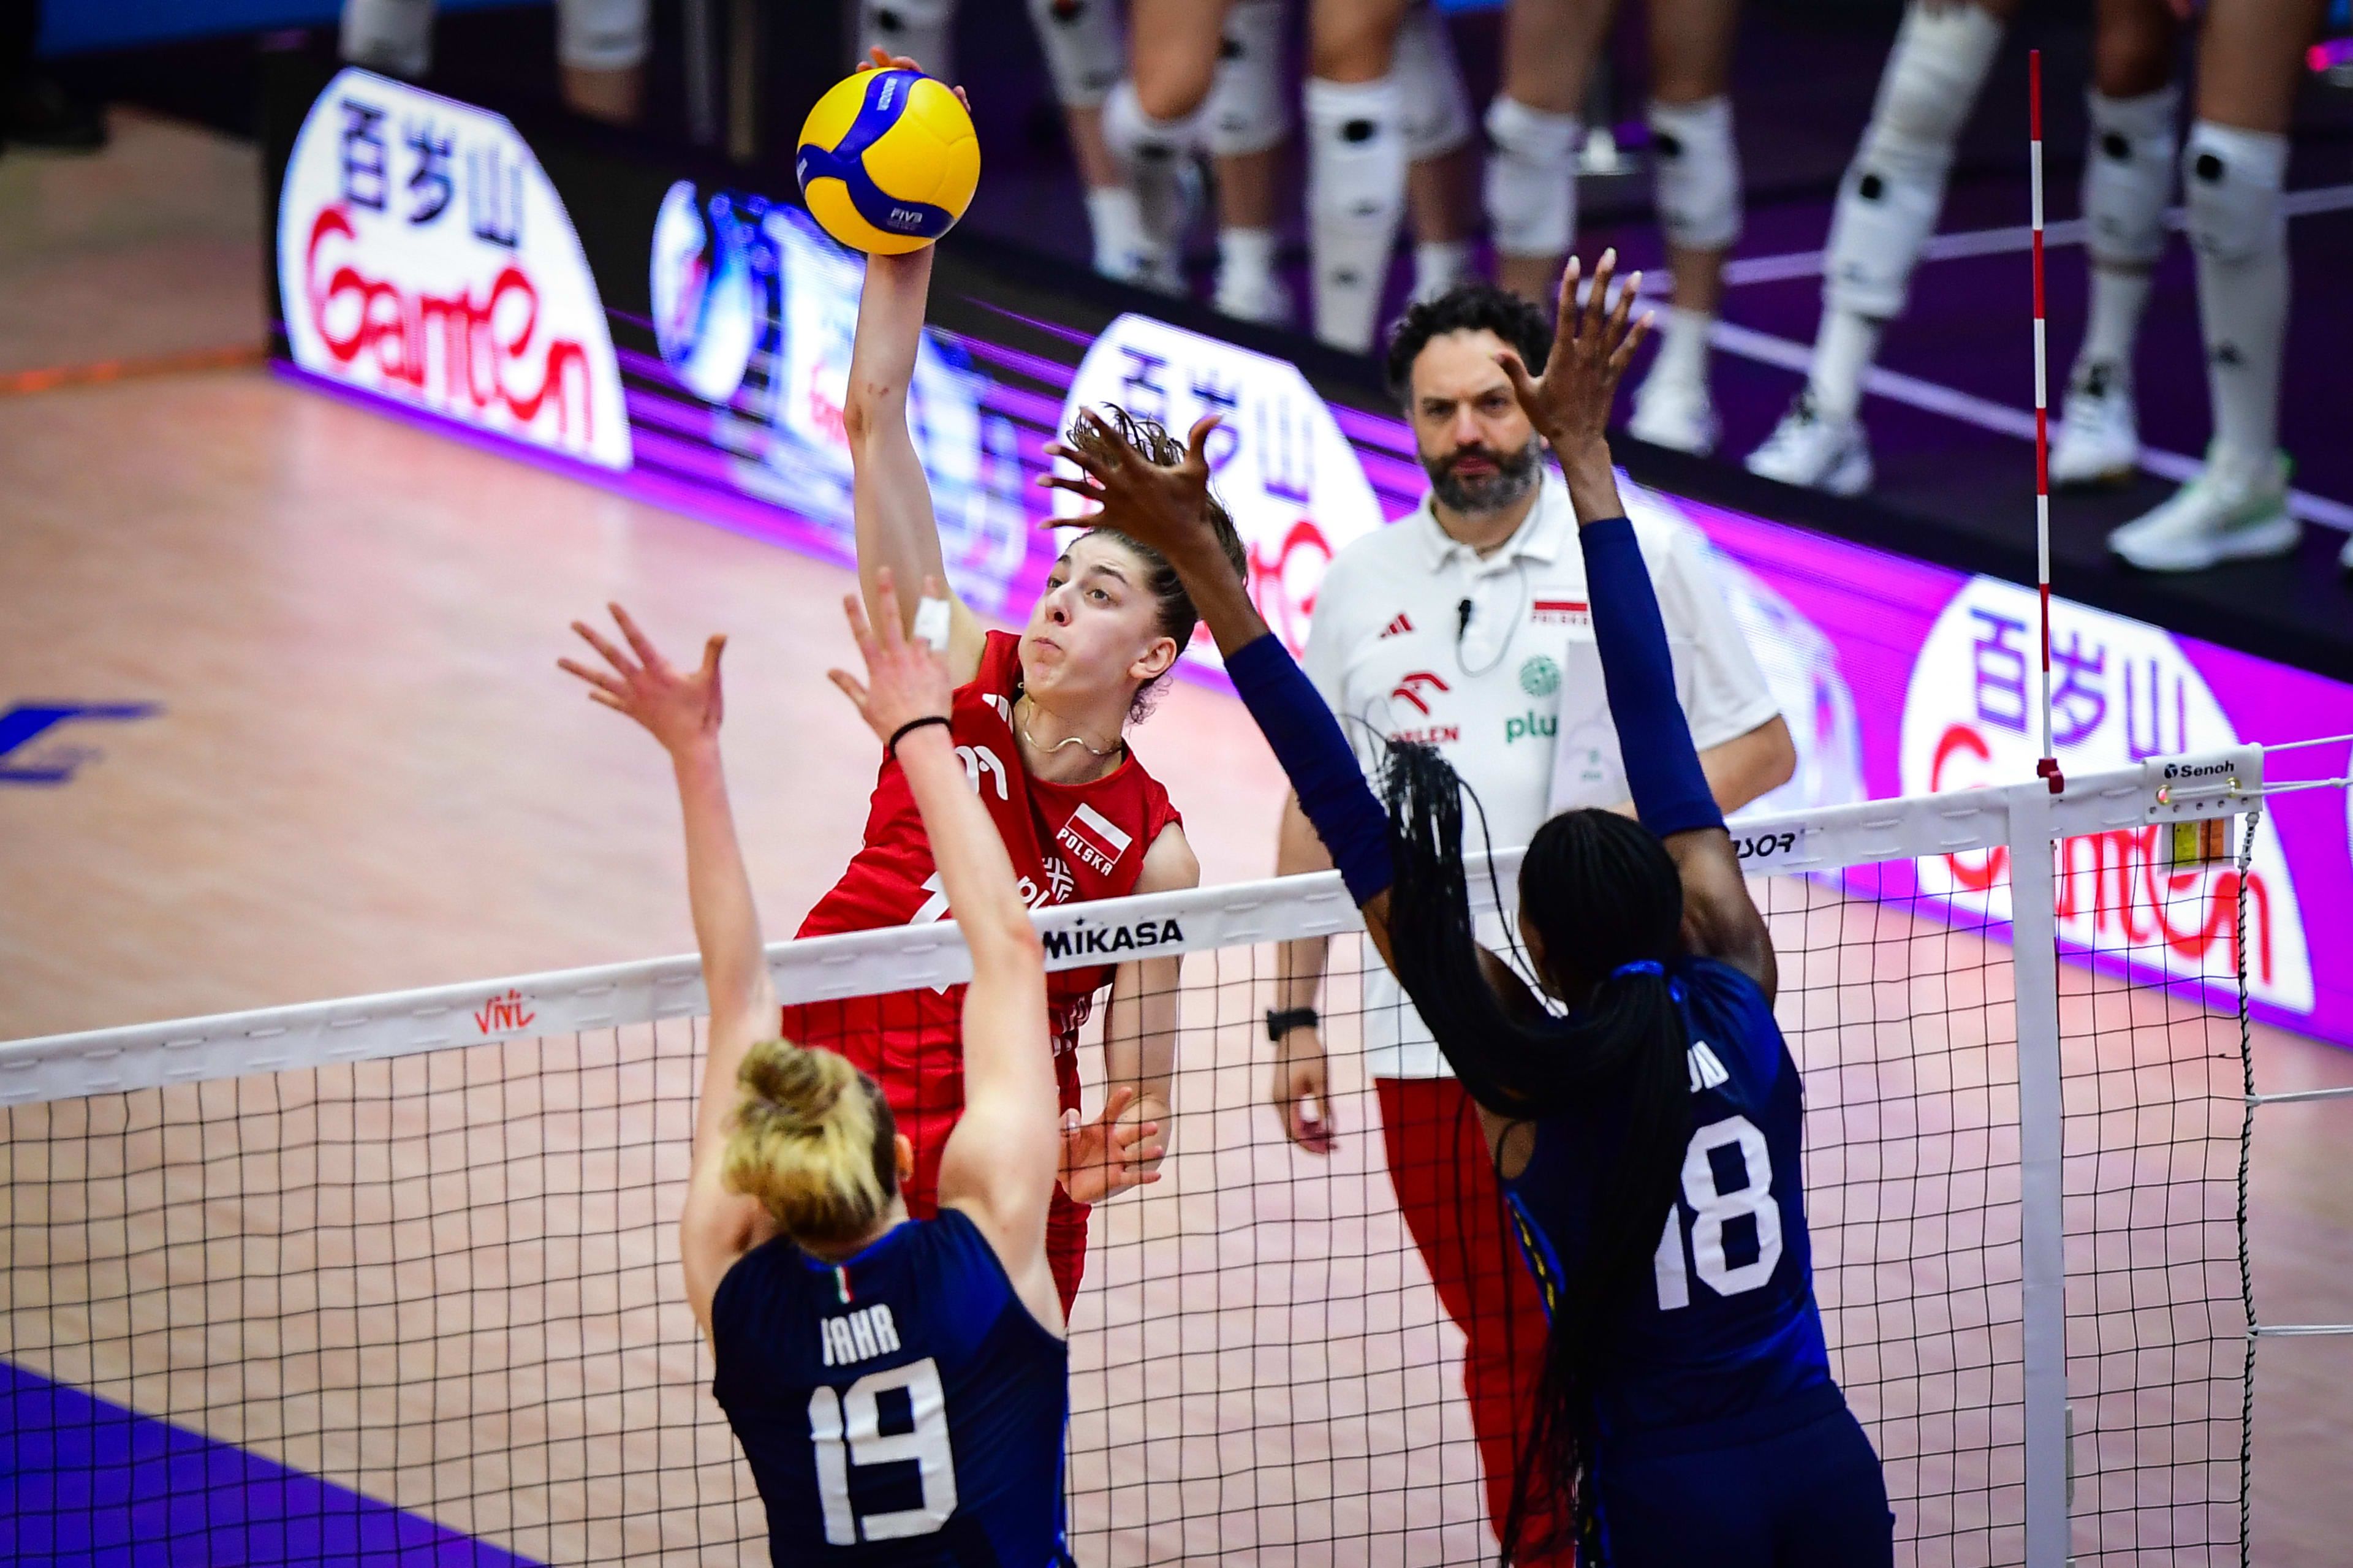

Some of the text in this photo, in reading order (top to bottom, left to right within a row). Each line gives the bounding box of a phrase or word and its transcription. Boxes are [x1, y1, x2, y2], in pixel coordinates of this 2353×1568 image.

[339, 97, 526, 249] 百岁山
[305, 206, 594, 444] Ganten
[1506, 710, 1558, 744] plu
[1969, 605, 2188, 763] 百岁山
[2180, 760, 2235, 778] Senoh
[1056, 827, 1115, 877] POLSKA
[1042, 917, 1185, 960] MIKASA
[474, 988, 537, 1036] VNL
[1654, 1114, 1783, 1311] 18
[808, 1356, 959, 1547] 19
